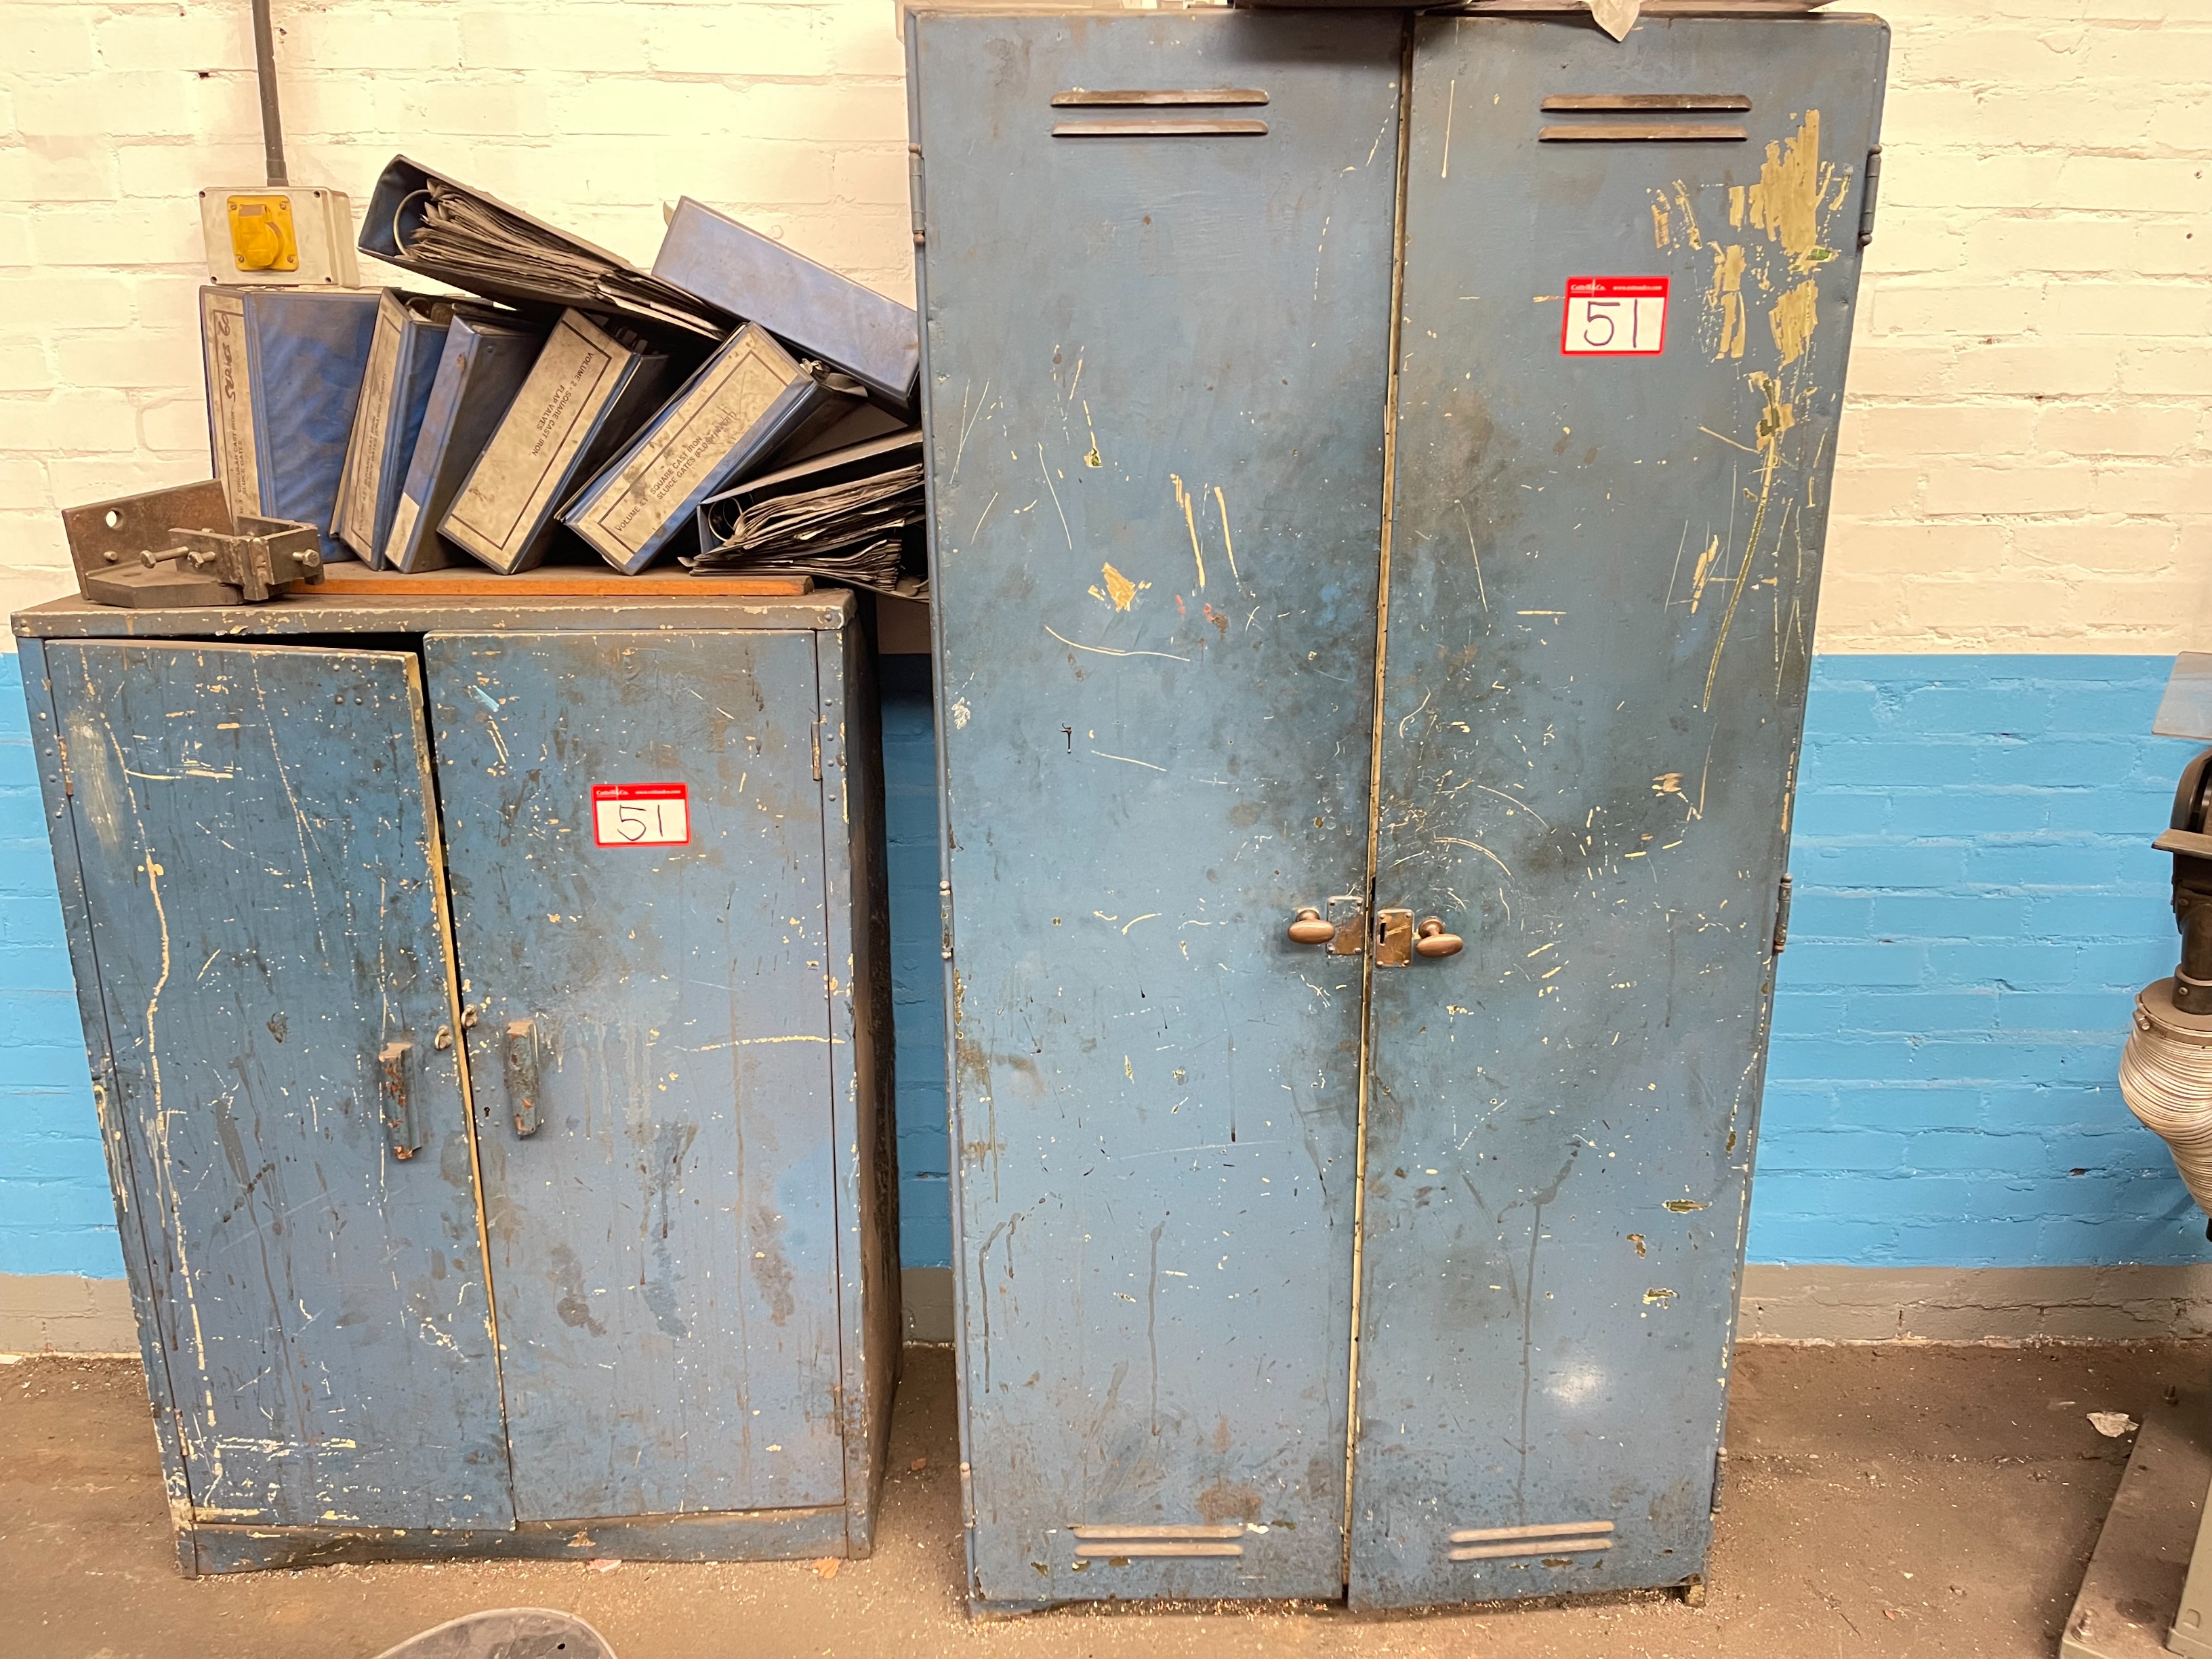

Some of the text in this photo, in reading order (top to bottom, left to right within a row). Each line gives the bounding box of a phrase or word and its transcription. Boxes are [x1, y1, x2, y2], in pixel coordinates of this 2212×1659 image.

[1584, 298, 1639, 349] 51
[218, 312, 236, 403] SERIES 60
[573, 352, 594, 382] VOLUME
[536, 384, 565, 431] FLAP VALVES
[552, 390, 572, 420] SQUARE
[531, 438, 545, 457] IRON
[544, 419, 555, 438] CAST
[615, 506, 640, 532] VOLUME
[650, 469, 675, 495] SQUARE
[673, 451, 689, 469] CAST
[687, 436, 703, 453] IRON
[656, 477, 678, 500] SLUICE
[676, 457, 697, 479] GATES
[617, 804, 663, 842] 51
